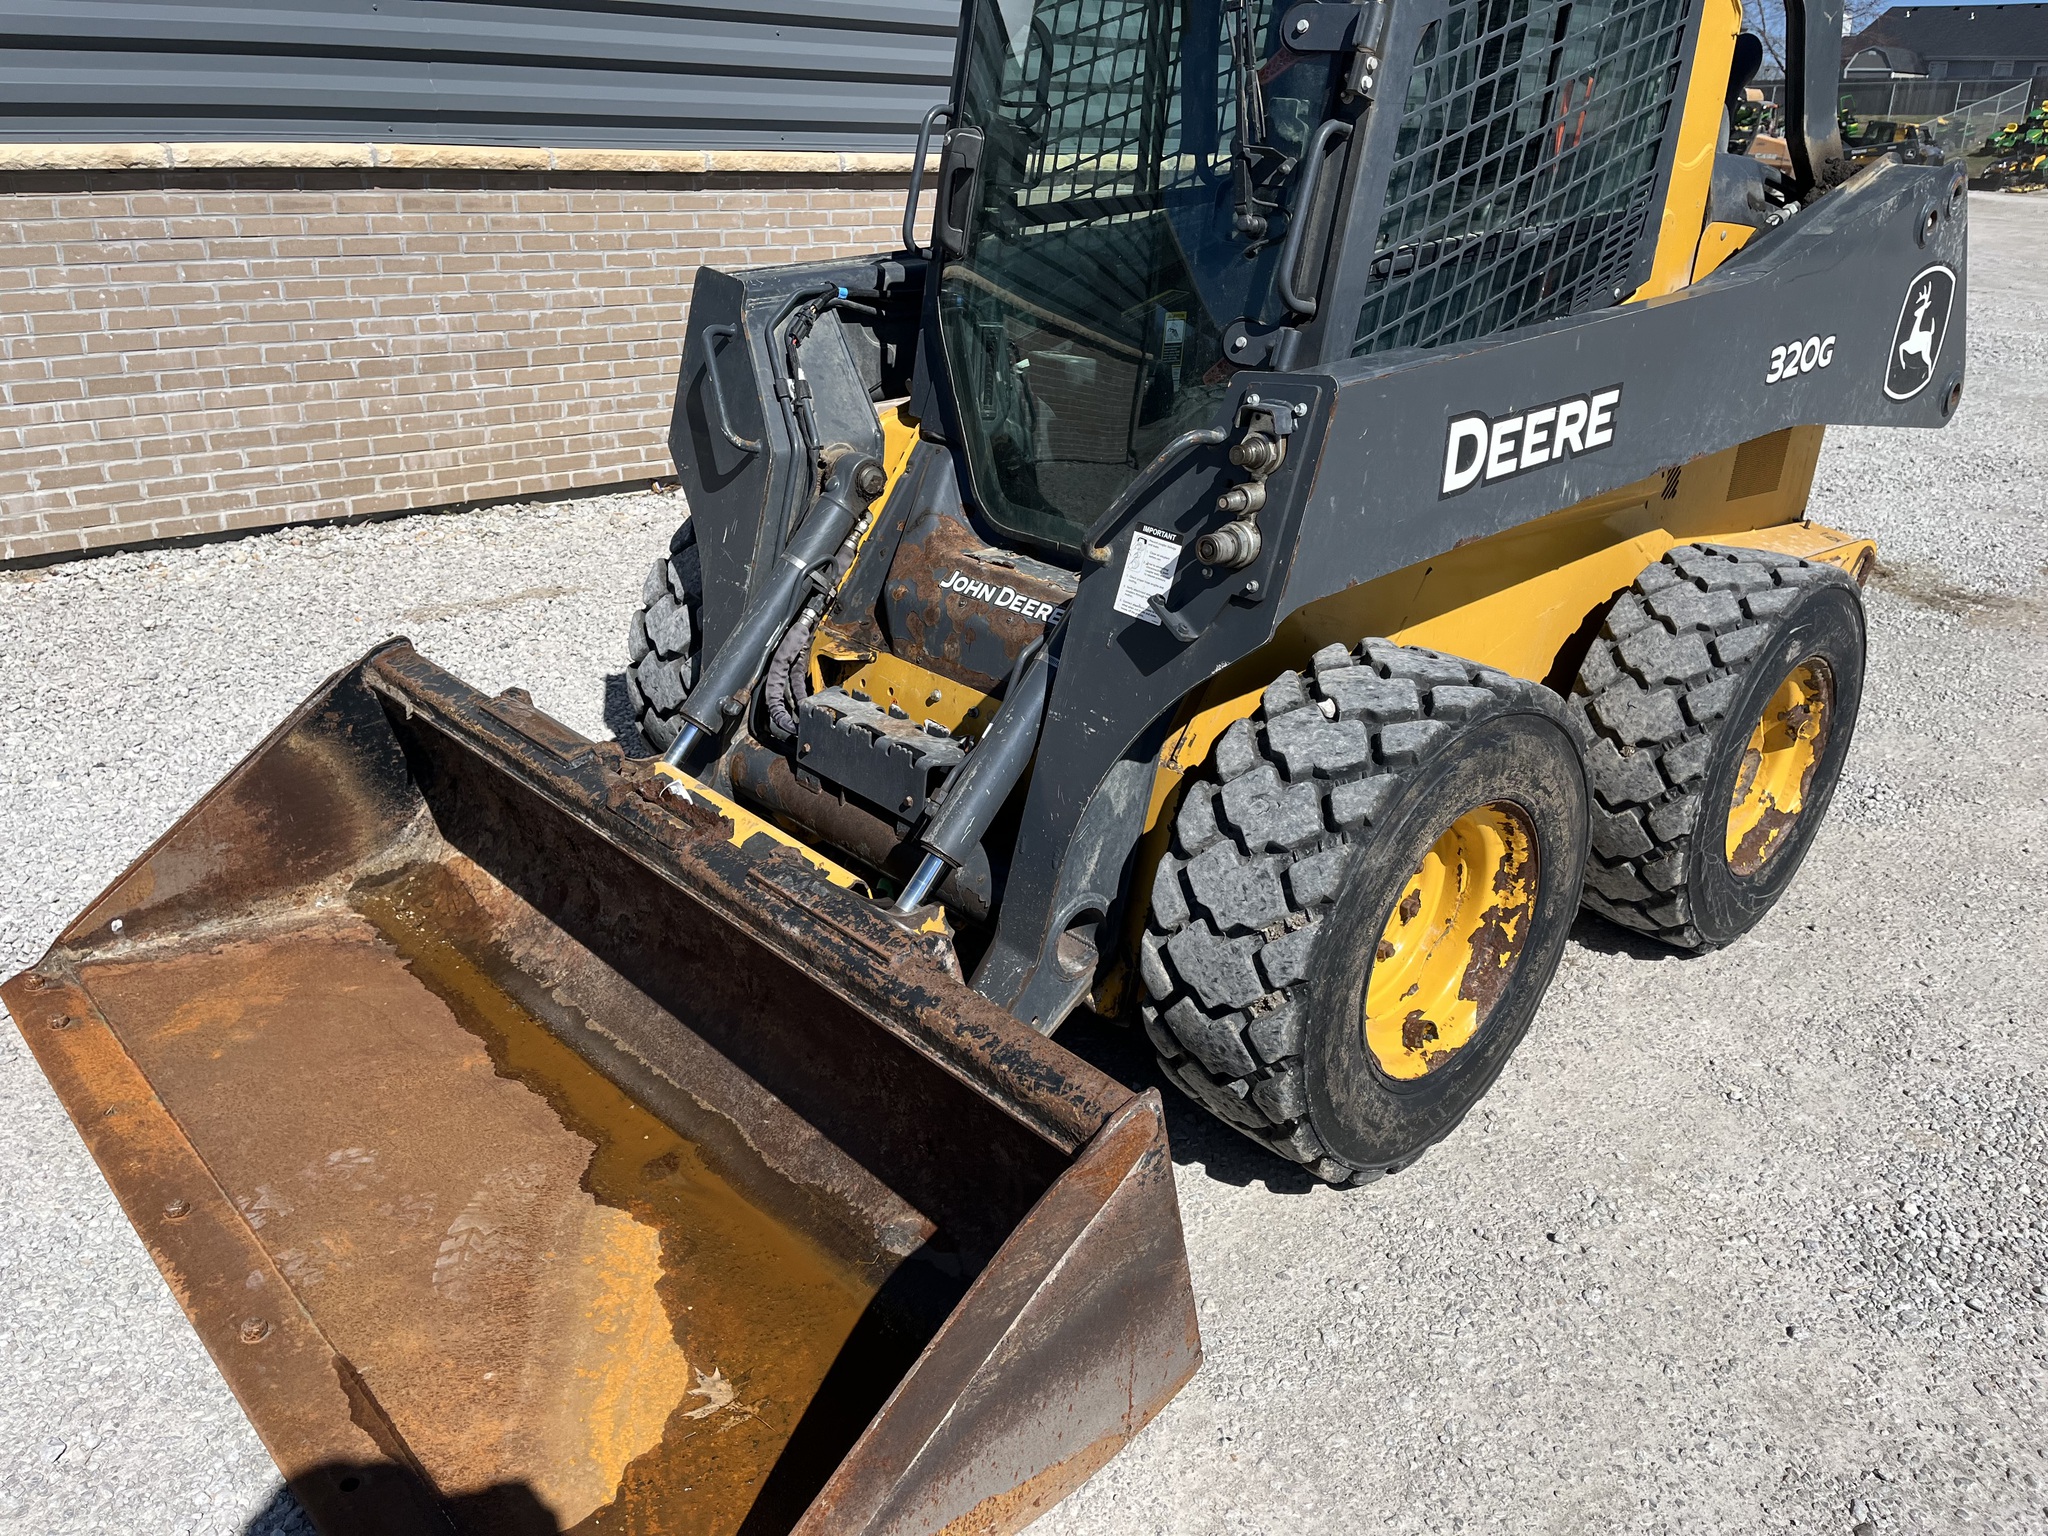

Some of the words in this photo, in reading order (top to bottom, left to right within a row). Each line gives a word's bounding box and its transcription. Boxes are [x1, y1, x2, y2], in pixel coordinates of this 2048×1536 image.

[1765, 335, 1837, 384] 320G
[1441, 387, 1621, 495] DEERE
[1142, 525, 1177, 541] IMPORTANT
[940, 569, 997, 603] JOHN
[994, 586, 1066, 625] DEERE
